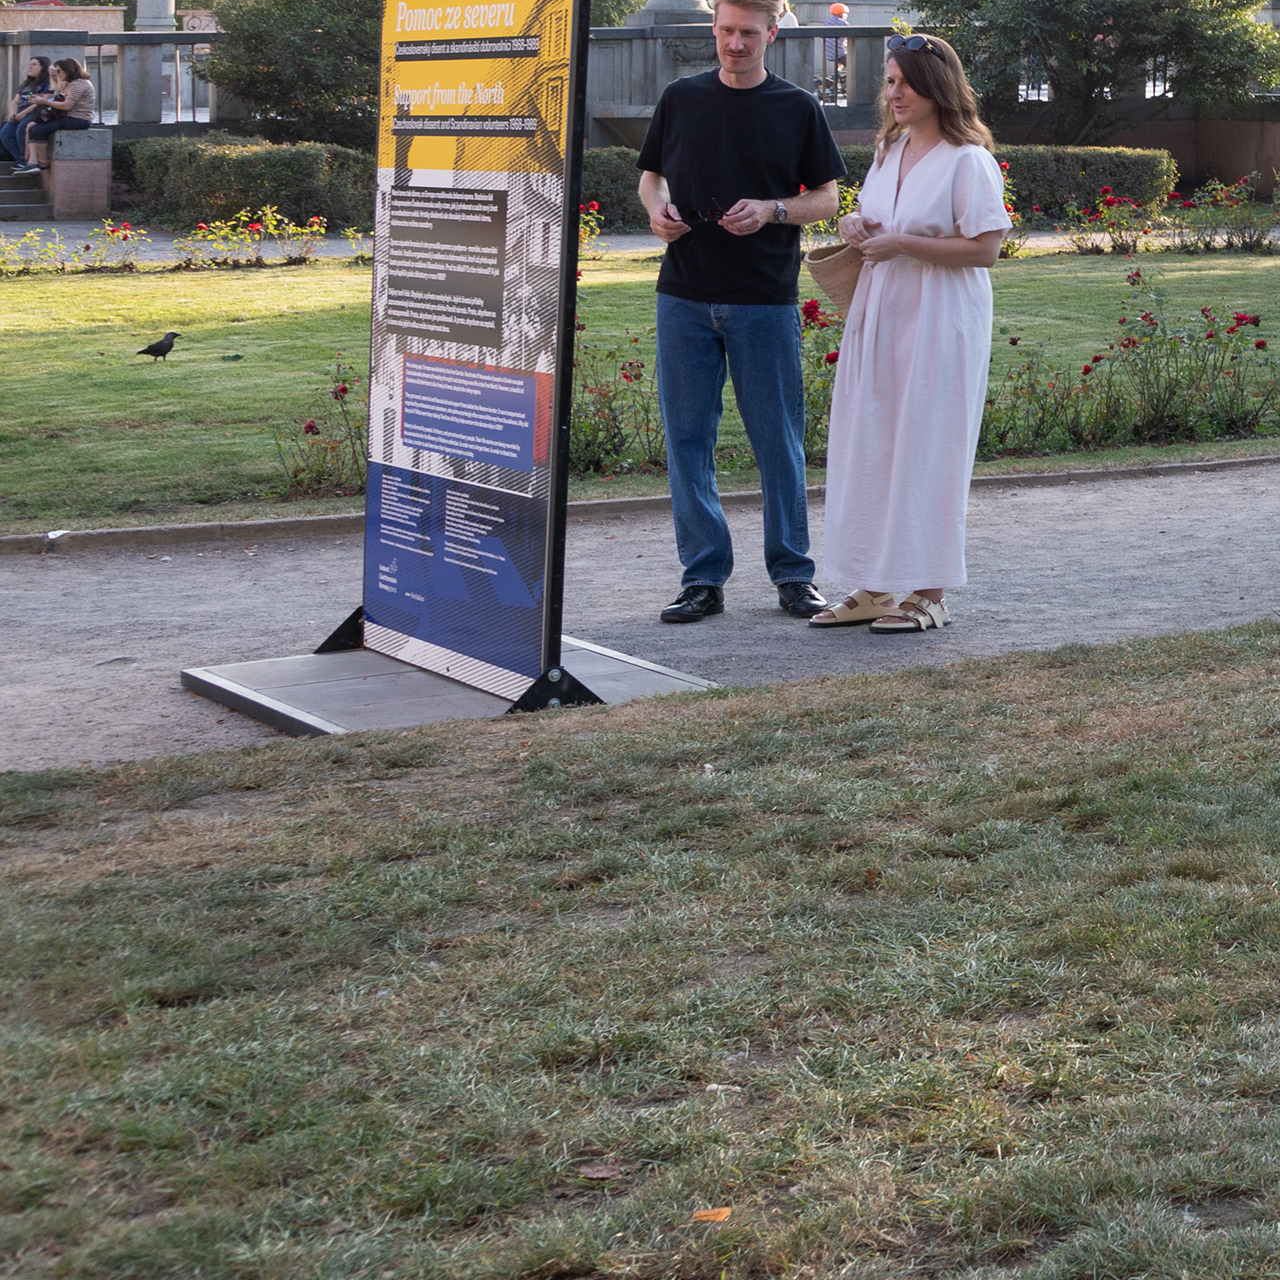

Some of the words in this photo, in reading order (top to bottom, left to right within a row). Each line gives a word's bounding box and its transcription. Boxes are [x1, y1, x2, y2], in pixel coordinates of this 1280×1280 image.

[396, 2, 442, 32] Pomoc
[444, 6, 461, 30] ze
[464, 3, 514, 29] severu
[394, 84, 432, 110] Support
[430, 82, 456, 110] from
[458, 82, 472, 104] the
[474, 81, 504, 104] North
